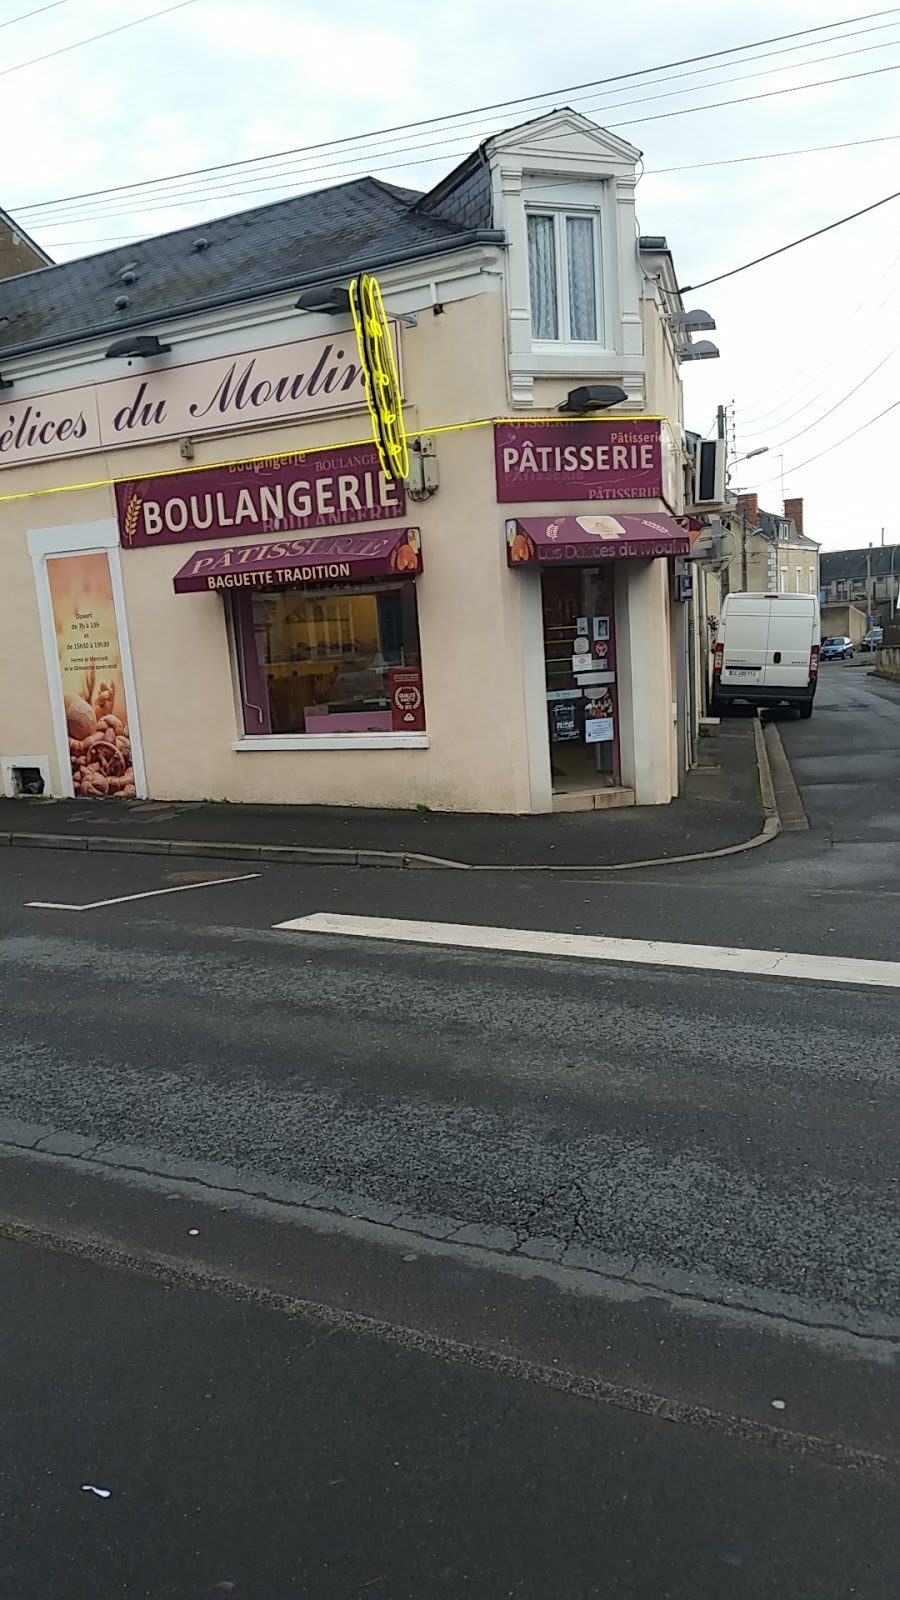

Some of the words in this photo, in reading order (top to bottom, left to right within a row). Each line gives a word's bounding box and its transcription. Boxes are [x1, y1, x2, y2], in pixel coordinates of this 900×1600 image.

[114, 382, 167, 431] du
[189, 344, 368, 417] Moulin
[315, 453, 380, 471] BOULANGE
[503, 440, 654, 473] PÂTISSERIE
[143, 469, 399, 535] BOULANGERIE
[188, 537, 389, 575] PÂTISSERIE
[618, 542, 637, 557] du
[208, 568, 273, 590] BAGUETTE
[275, 563, 350, 583] TRADITION
